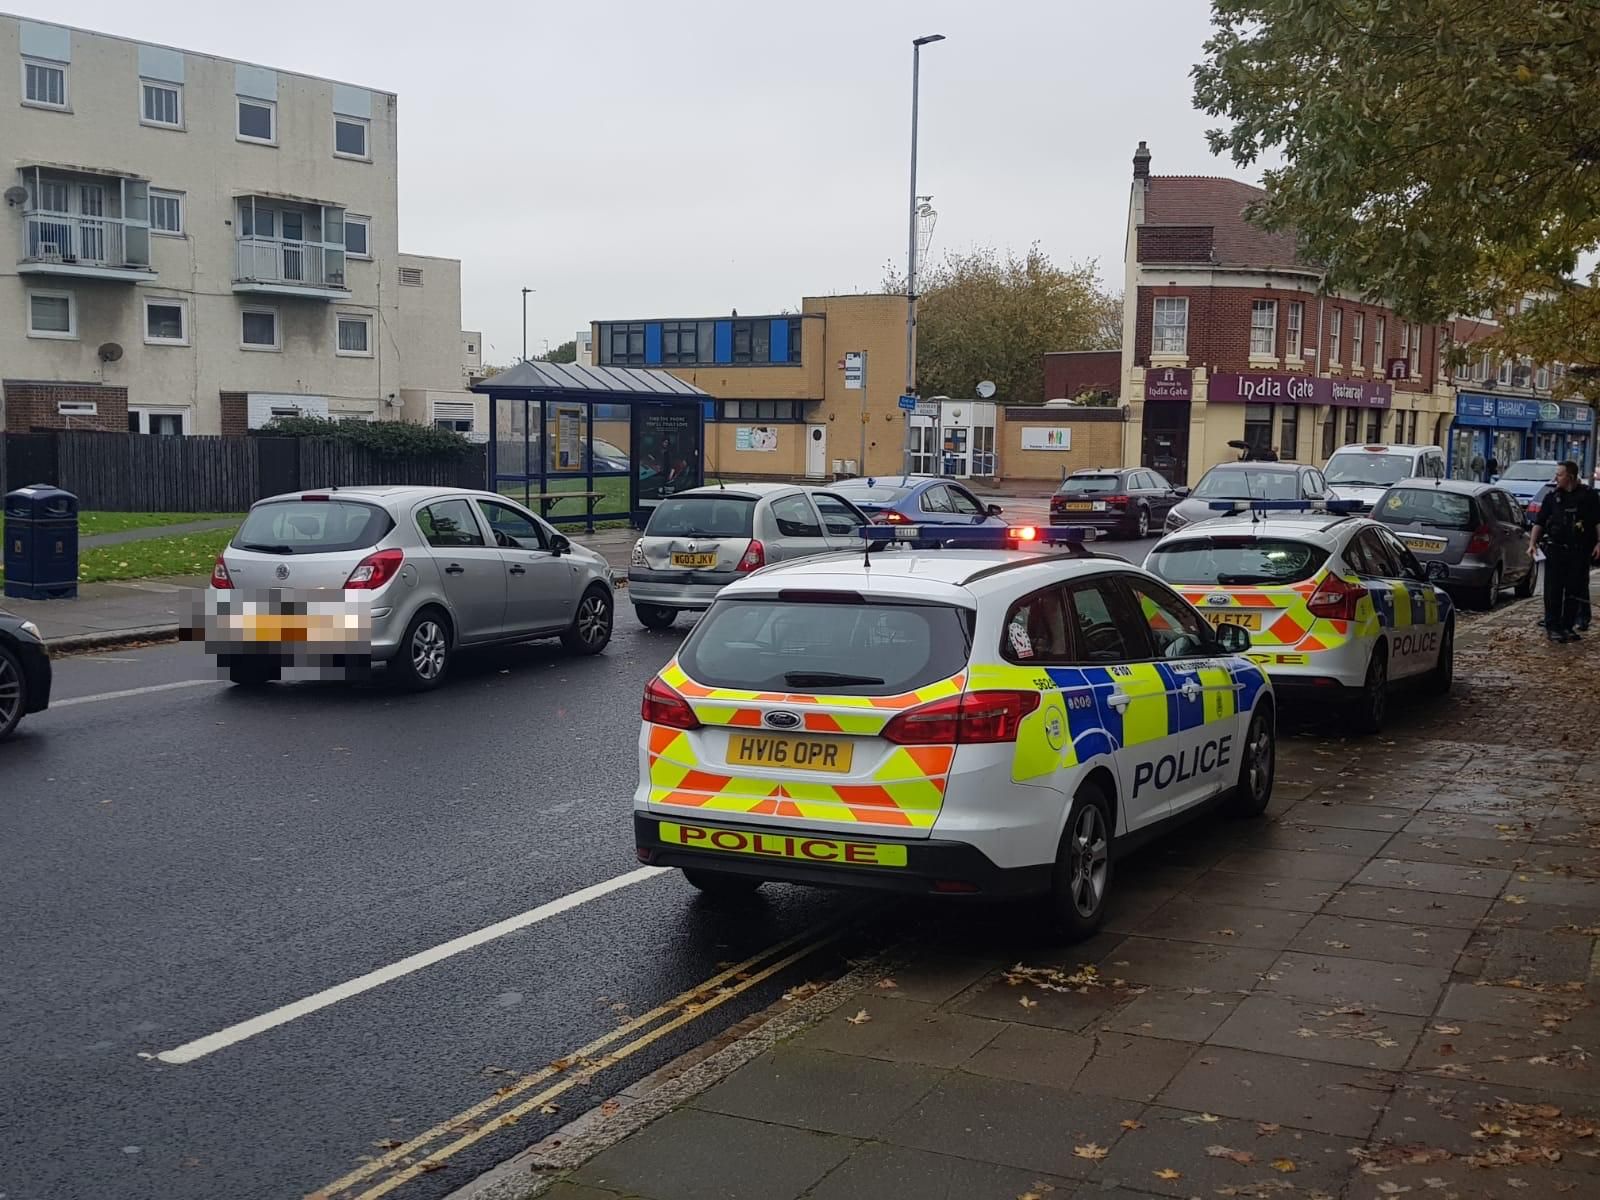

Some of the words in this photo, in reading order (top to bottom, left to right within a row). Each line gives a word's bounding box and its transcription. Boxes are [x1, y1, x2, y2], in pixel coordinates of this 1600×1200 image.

[1150, 387, 1168, 397] India
[1170, 387, 1188, 397] Gate
[1238, 376, 1280, 400] India
[1287, 376, 1313, 400] Gate
[1332, 382, 1363, 402] Restaurant
[674, 554, 695, 564] WG03
[697, 554, 714, 564] JKV
[1392, 632, 1437, 658] POLICE
[740, 738, 788, 762] HV16
[793, 742, 838, 767] OPR
[1132, 735, 1232, 799] POLICE
[680, 826, 879, 863] POLICE
